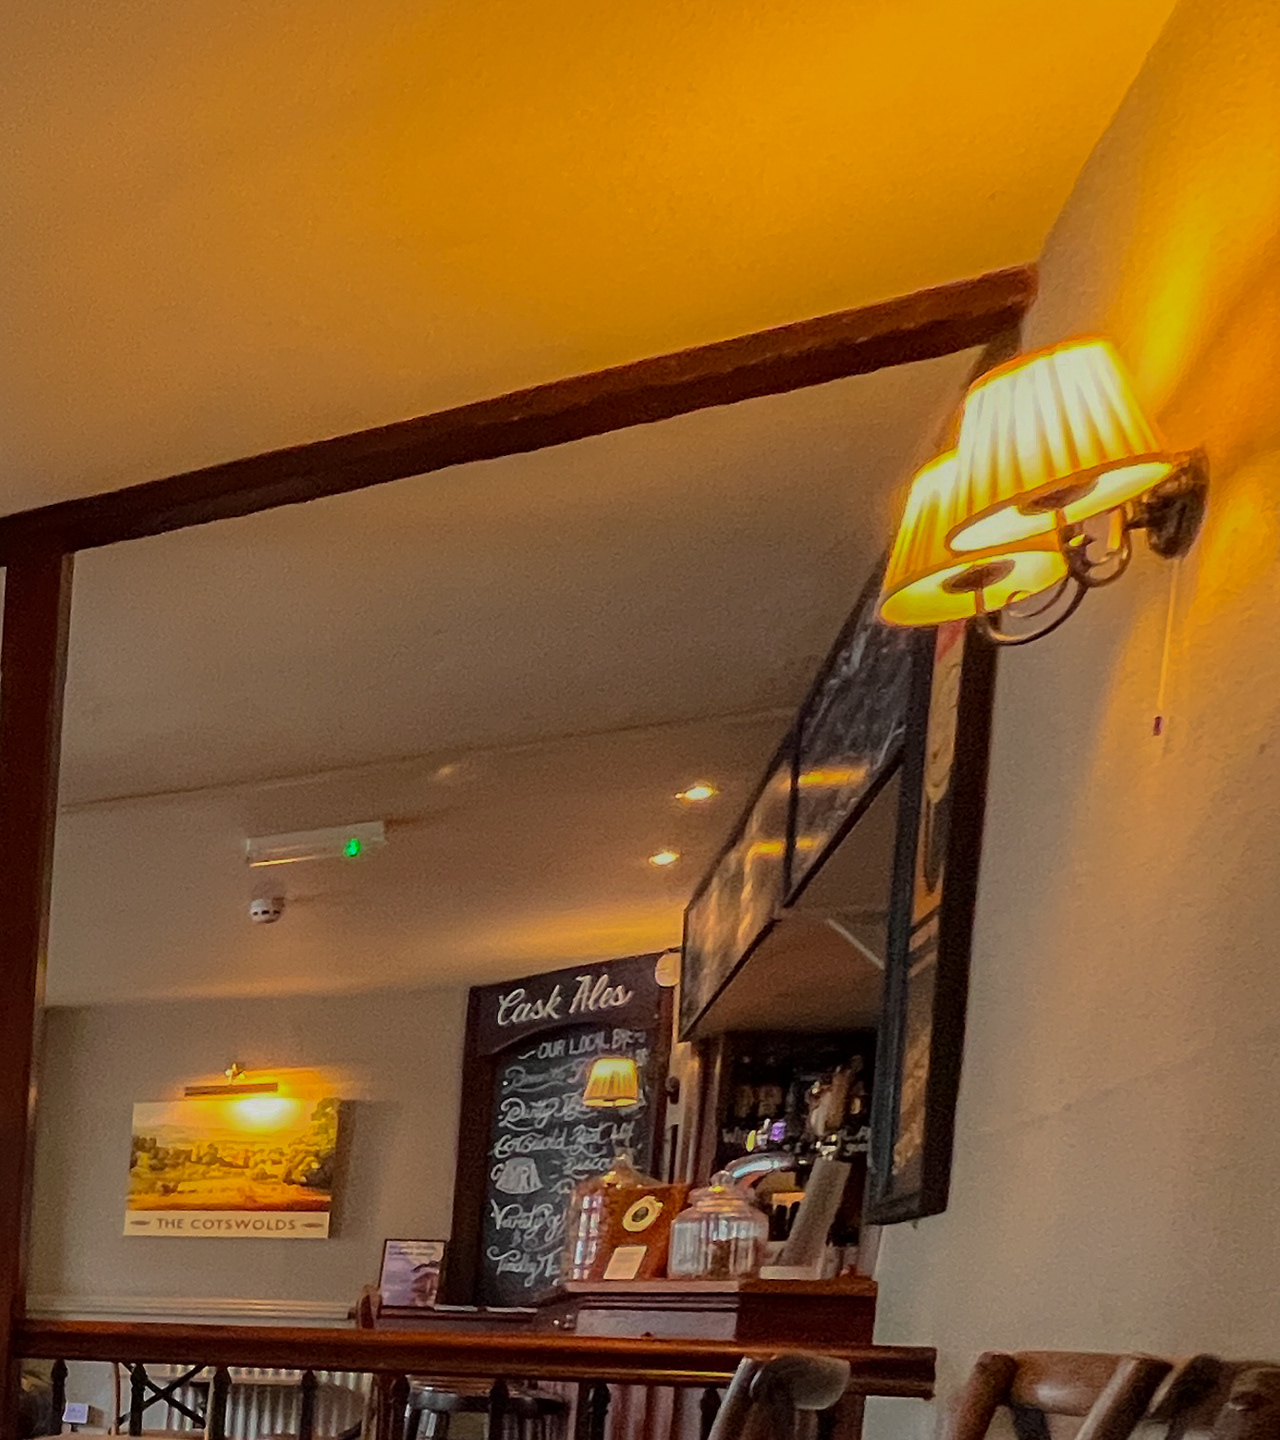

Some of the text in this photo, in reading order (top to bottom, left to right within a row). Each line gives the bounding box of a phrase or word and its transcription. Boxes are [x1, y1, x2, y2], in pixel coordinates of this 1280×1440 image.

[497, 973, 635, 1026] Cask Ales
[537, 1039, 566, 1059] OUR
[569, 1031, 611, 1055] LOCAL
[156, 1217, 297, 1231] THE COTSWOLDS
